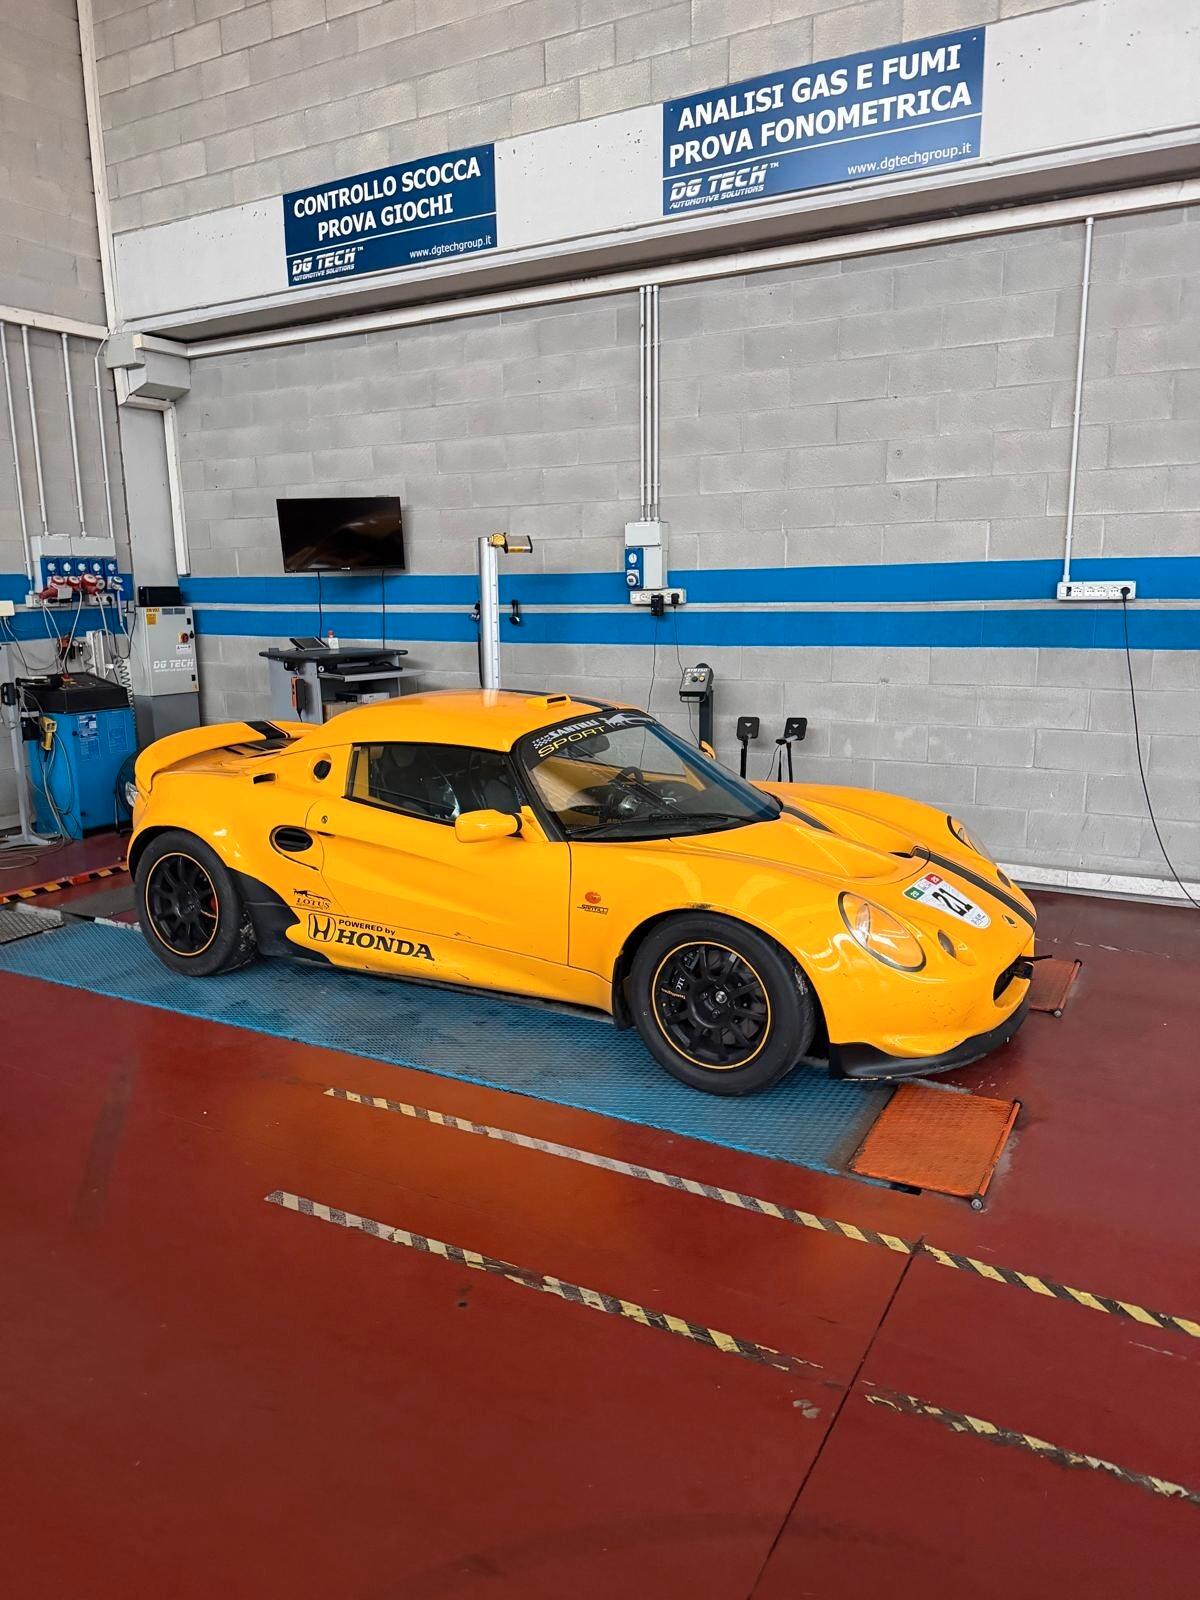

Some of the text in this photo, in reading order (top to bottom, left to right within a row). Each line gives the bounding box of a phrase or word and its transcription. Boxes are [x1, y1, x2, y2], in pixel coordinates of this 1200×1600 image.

[678, 44, 962, 132] ANALISI GAS E FUMI
[669, 81, 972, 168] PROVA FONOMETRICA
[847, 142, 972, 175] www.dgtechgroup.it
[293, 156, 481, 218] CONTROLLO SCOCCA
[669, 184, 765, 210] AUTOMOTIVE SOLUTIONS
[670, 177, 703, 202] DG
[318, 193, 454, 242] PROVA GIOCHI
[409, 235, 492, 259] www.dgtechgroup.it
[292, 256, 313, 276] DG
[292, 263, 355, 282] AUTOMOTIVE SOLUTIONS
[169, 658, 194, 669] TECH
[537, 725, 605, 758] SPORT
[296, 897, 331, 910] LOTUS
[932, 887, 974, 917] 21
[338, 919, 396, 936] POWERED by
[335, 928, 435, 961] HONDA
